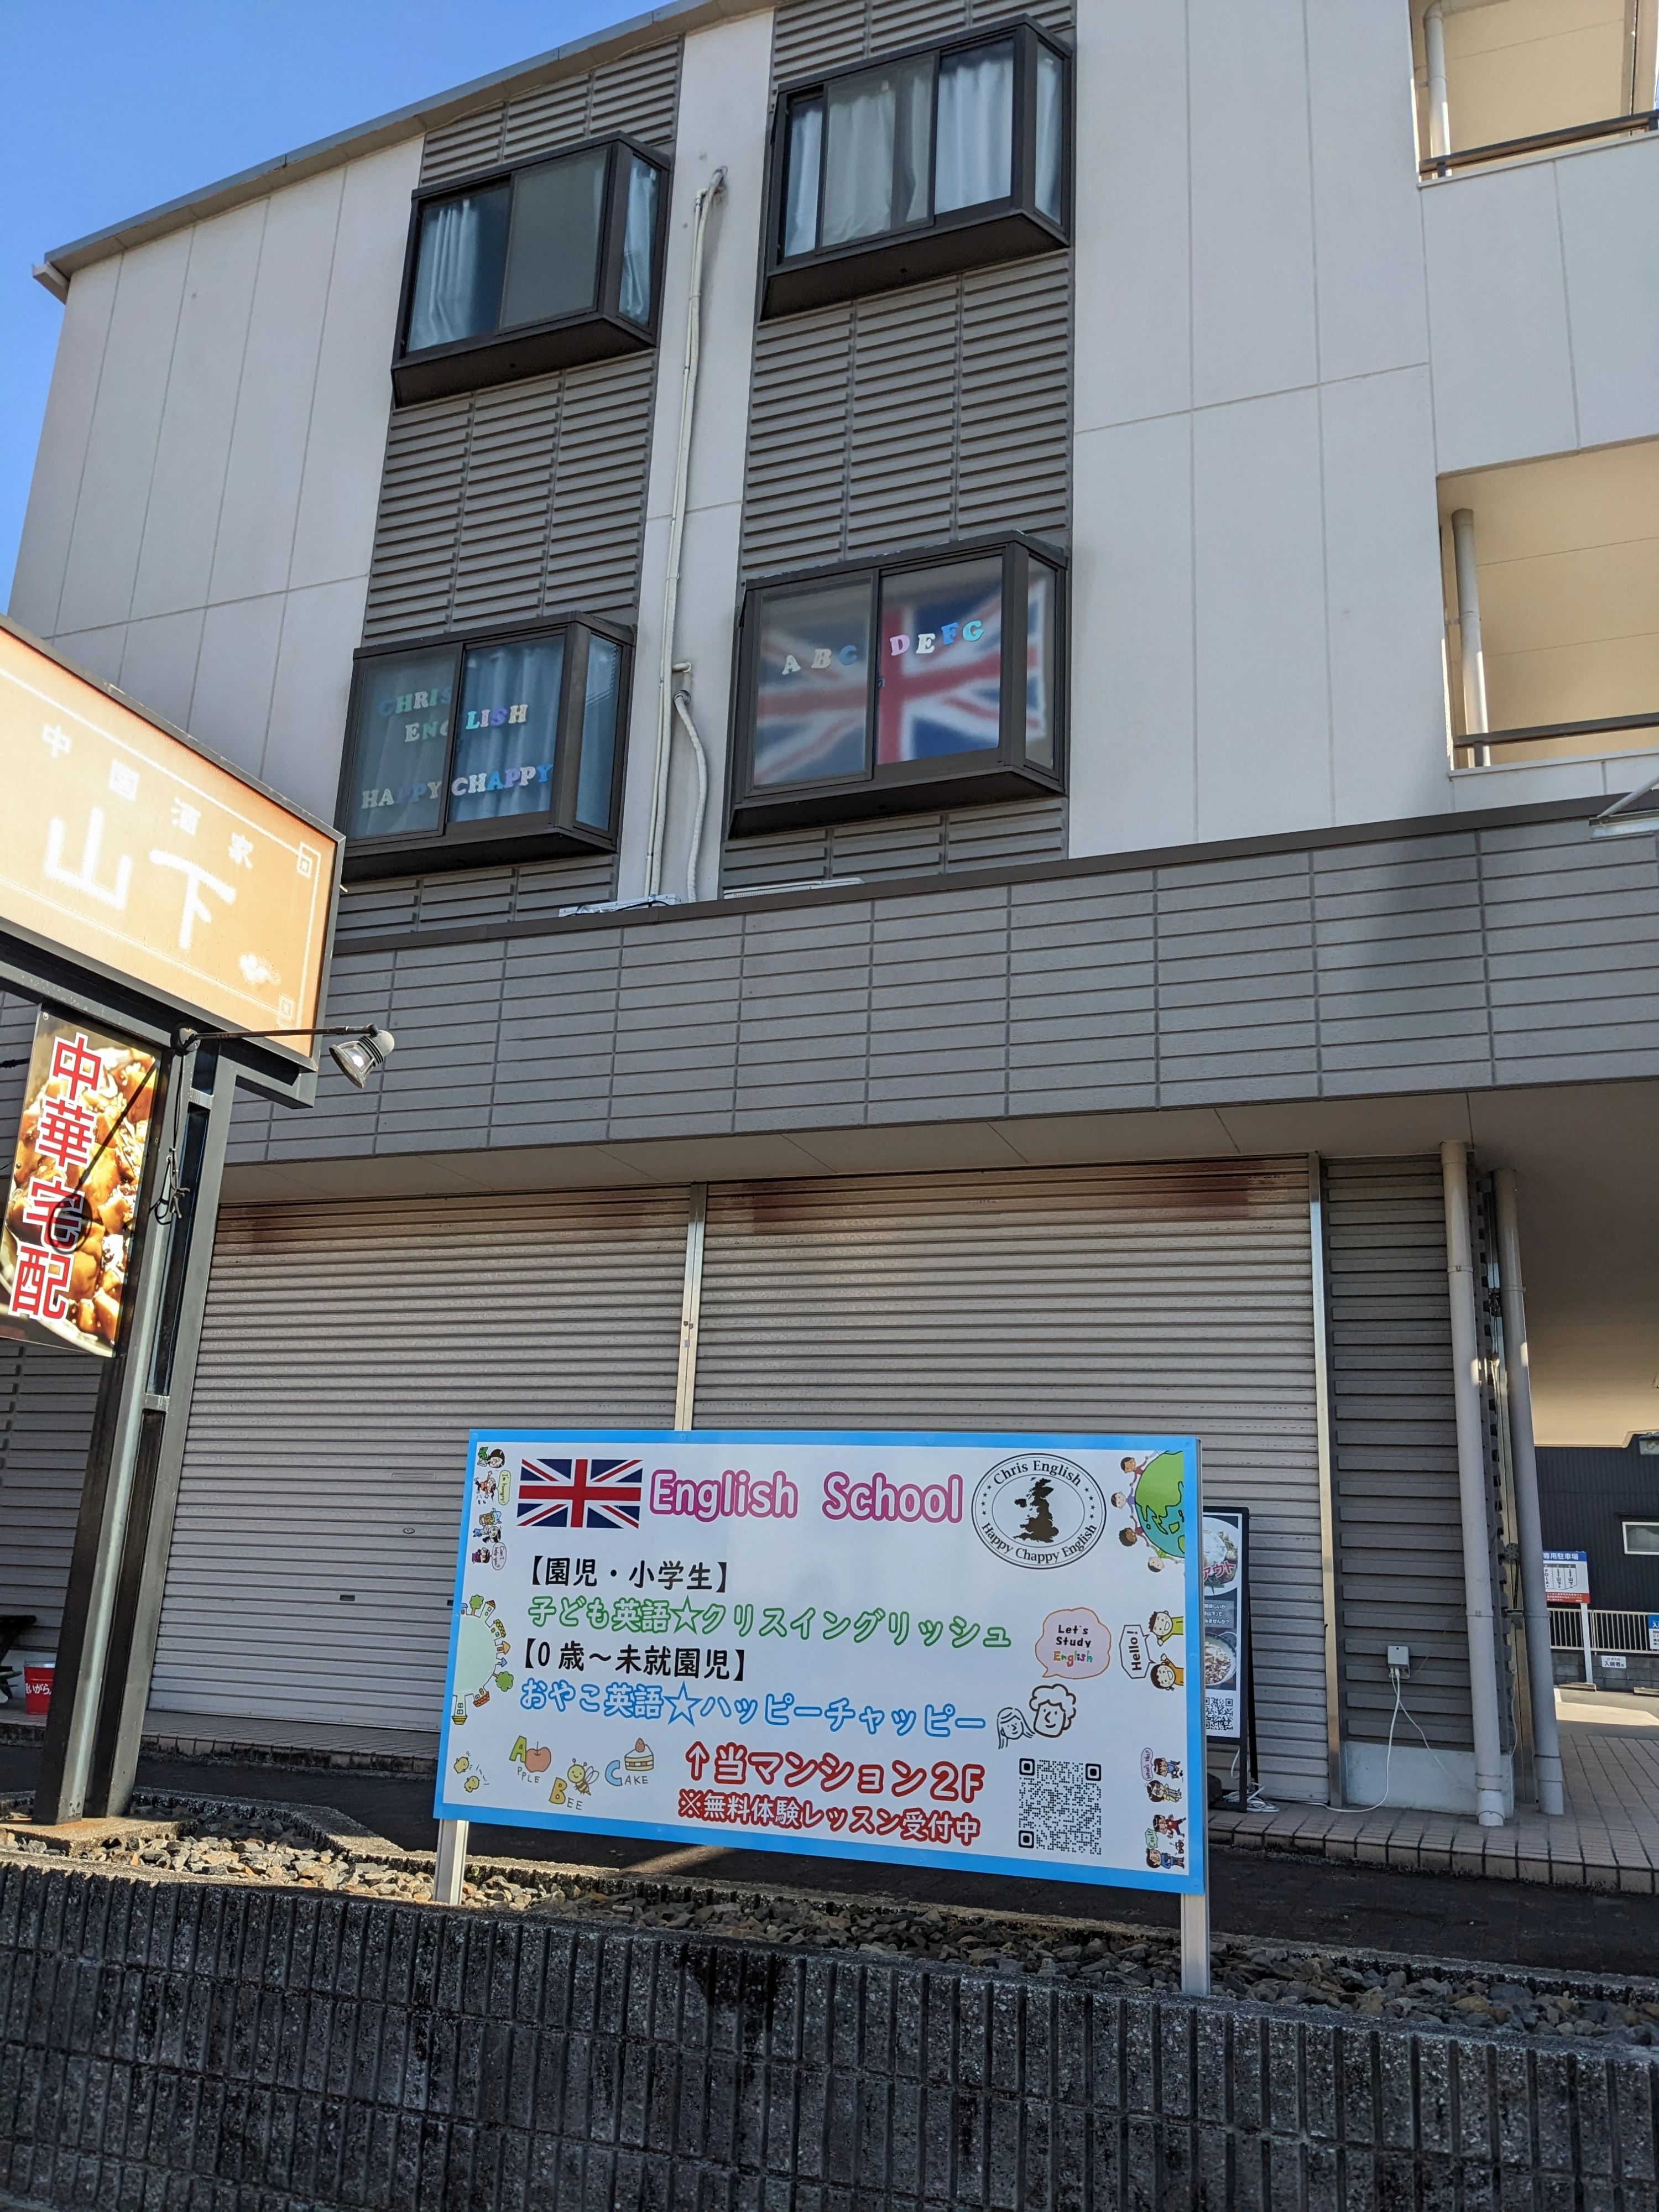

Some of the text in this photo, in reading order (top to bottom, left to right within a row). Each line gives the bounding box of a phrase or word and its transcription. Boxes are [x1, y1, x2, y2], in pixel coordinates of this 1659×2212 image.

[889, 620, 984, 656] DEFG
[361, 764, 552, 810] HAPPY CHAPPY
[43, 807, 237, 950] 山下
[8, 1032, 105, 1323] 中華宅配
[994, 1460, 1082, 1487] Chris English
[650, 1469, 963, 1524] English School
[982, 1522, 1097, 1564] Happy Chappy English
[1056, 1636, 1091, 1648] Study
[1058, 1625, 1088, 1635] Let's
[1053, 1650, 1093, 1667] English
